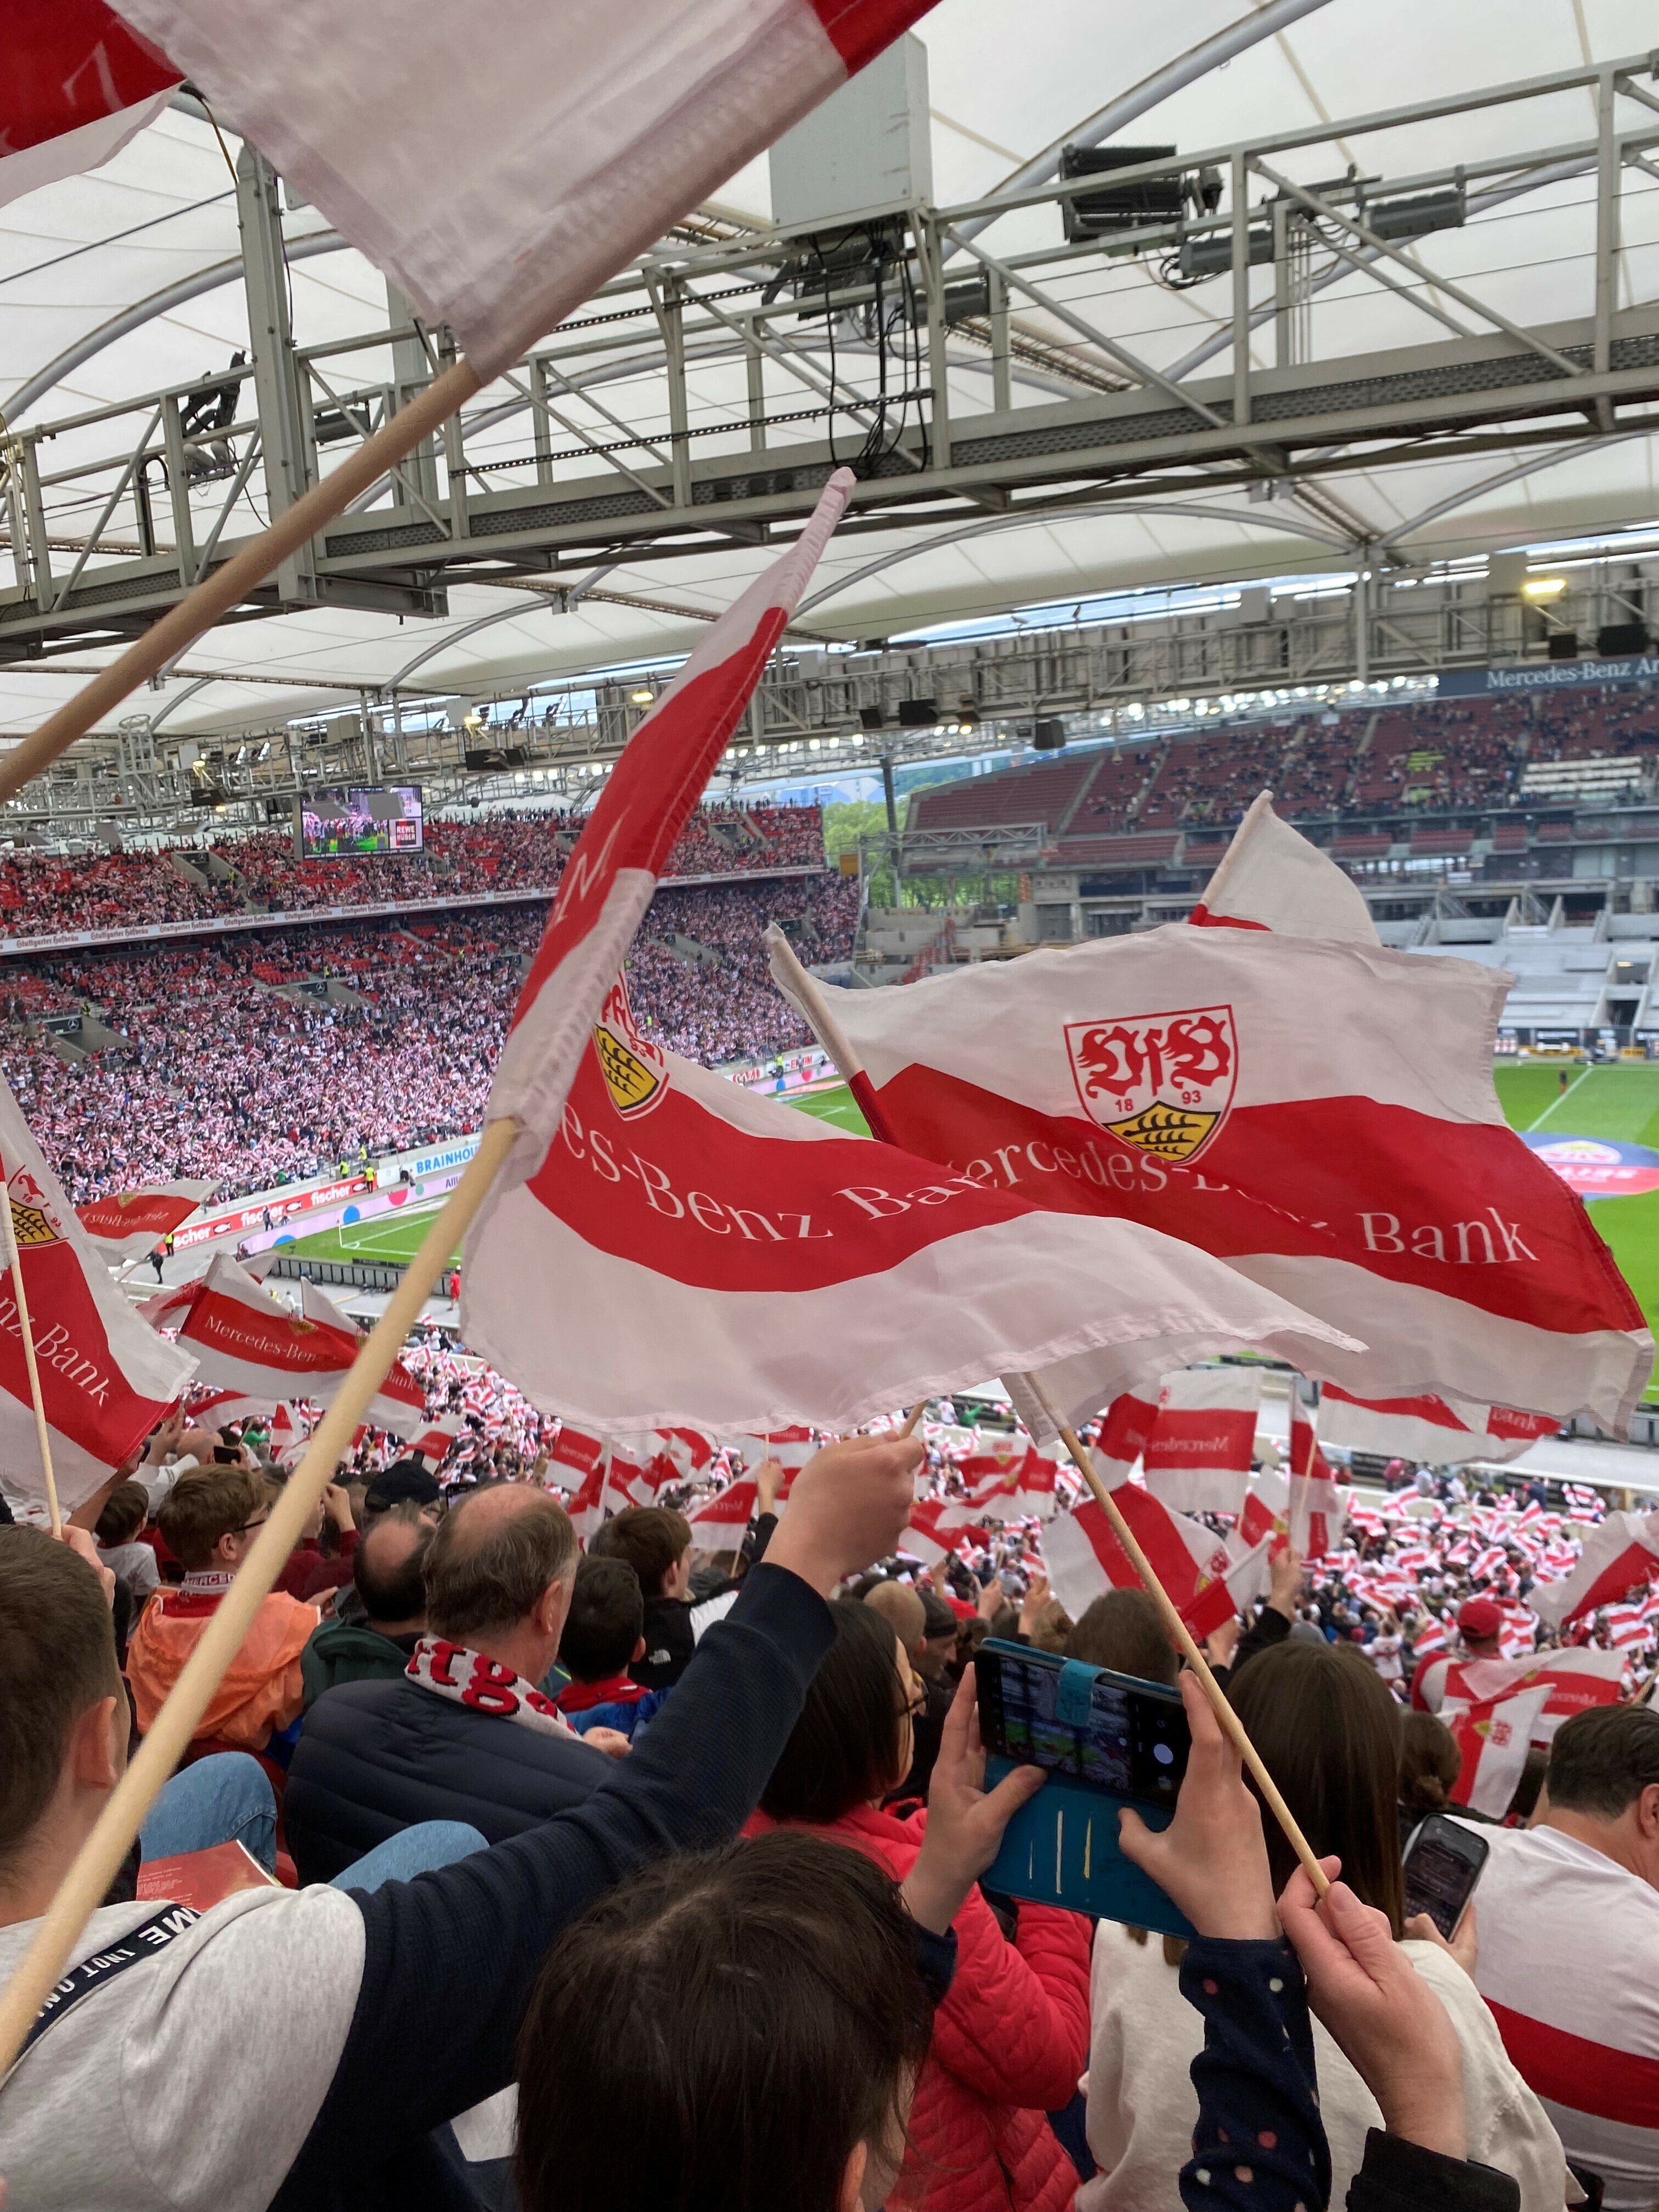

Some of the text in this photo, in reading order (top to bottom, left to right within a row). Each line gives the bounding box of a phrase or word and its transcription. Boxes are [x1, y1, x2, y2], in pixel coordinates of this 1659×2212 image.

[1486, 661, 1631, 689] Mercedes-Benz
[396, 825, 415, 834] REWE
[1114, 1088, 1202, 1113] 18 93
[558, 1102, 988, 1242] es-Benz Ba
[311, 1184, 351, 1206] fischer
[240, 1205, 284, 1227] fiscer
[172, 1225, 211, 1248] scher
[1356, 1206, 1539, 1265] Bank
[205, 1315, 318, 1363] Mercedes-Ben
[34, 1323, 109, 1407] Bank
[38, 1978, 76, 2018] ON
